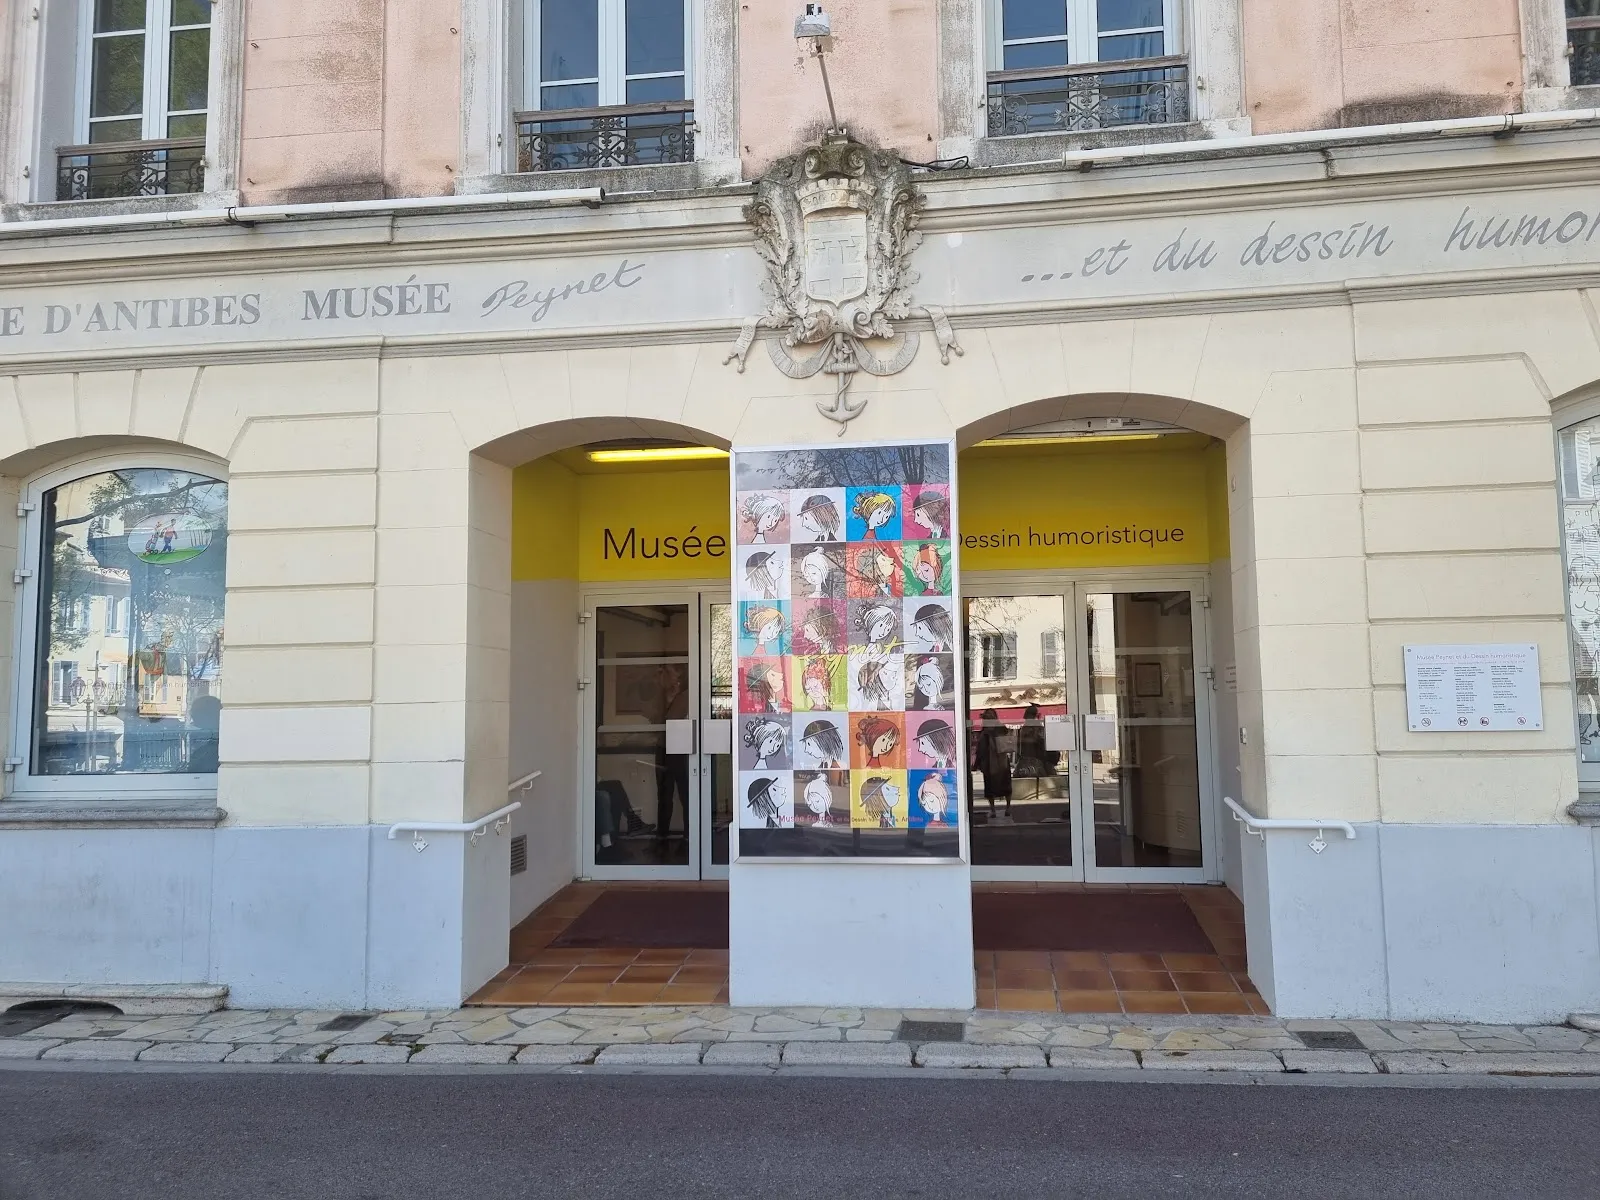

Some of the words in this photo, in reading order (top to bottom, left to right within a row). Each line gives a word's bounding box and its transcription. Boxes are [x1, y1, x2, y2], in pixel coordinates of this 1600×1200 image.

[1152, 226, 1218, 272] du
[1239, 220, 1394, 266] dessin
[43, 293, 262, 335] D'ANTIBES
[301, 273, 452, 321] MUSÉE
[480, 259, 646, 323] Peynet
[603, 525, 726, 560] Musée
[959, 528, 1020, 549] essin
[1028, 524, 1185, 549] humoristique
